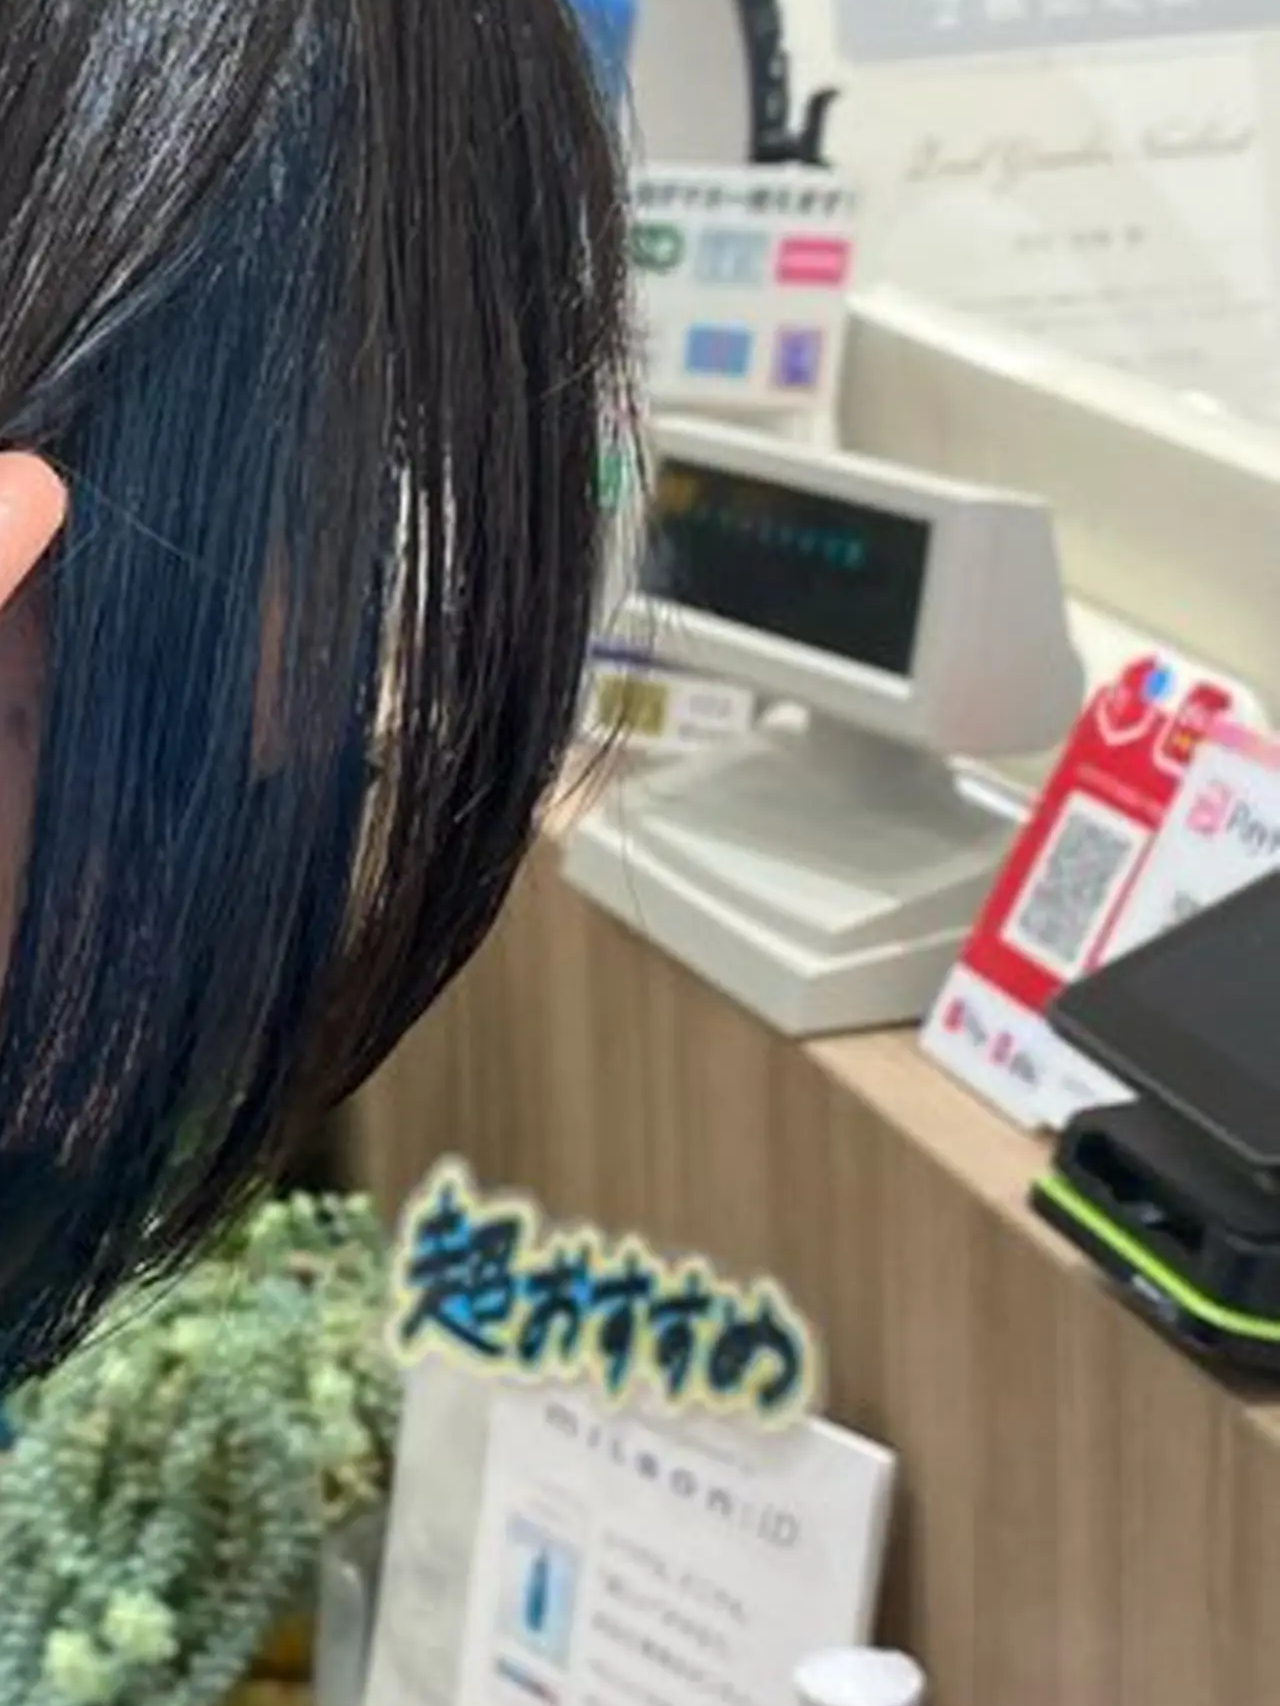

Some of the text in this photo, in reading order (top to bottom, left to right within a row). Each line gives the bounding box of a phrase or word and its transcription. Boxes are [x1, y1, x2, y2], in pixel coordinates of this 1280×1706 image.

[400, 1183, 806, 1415] 超おすすめ
